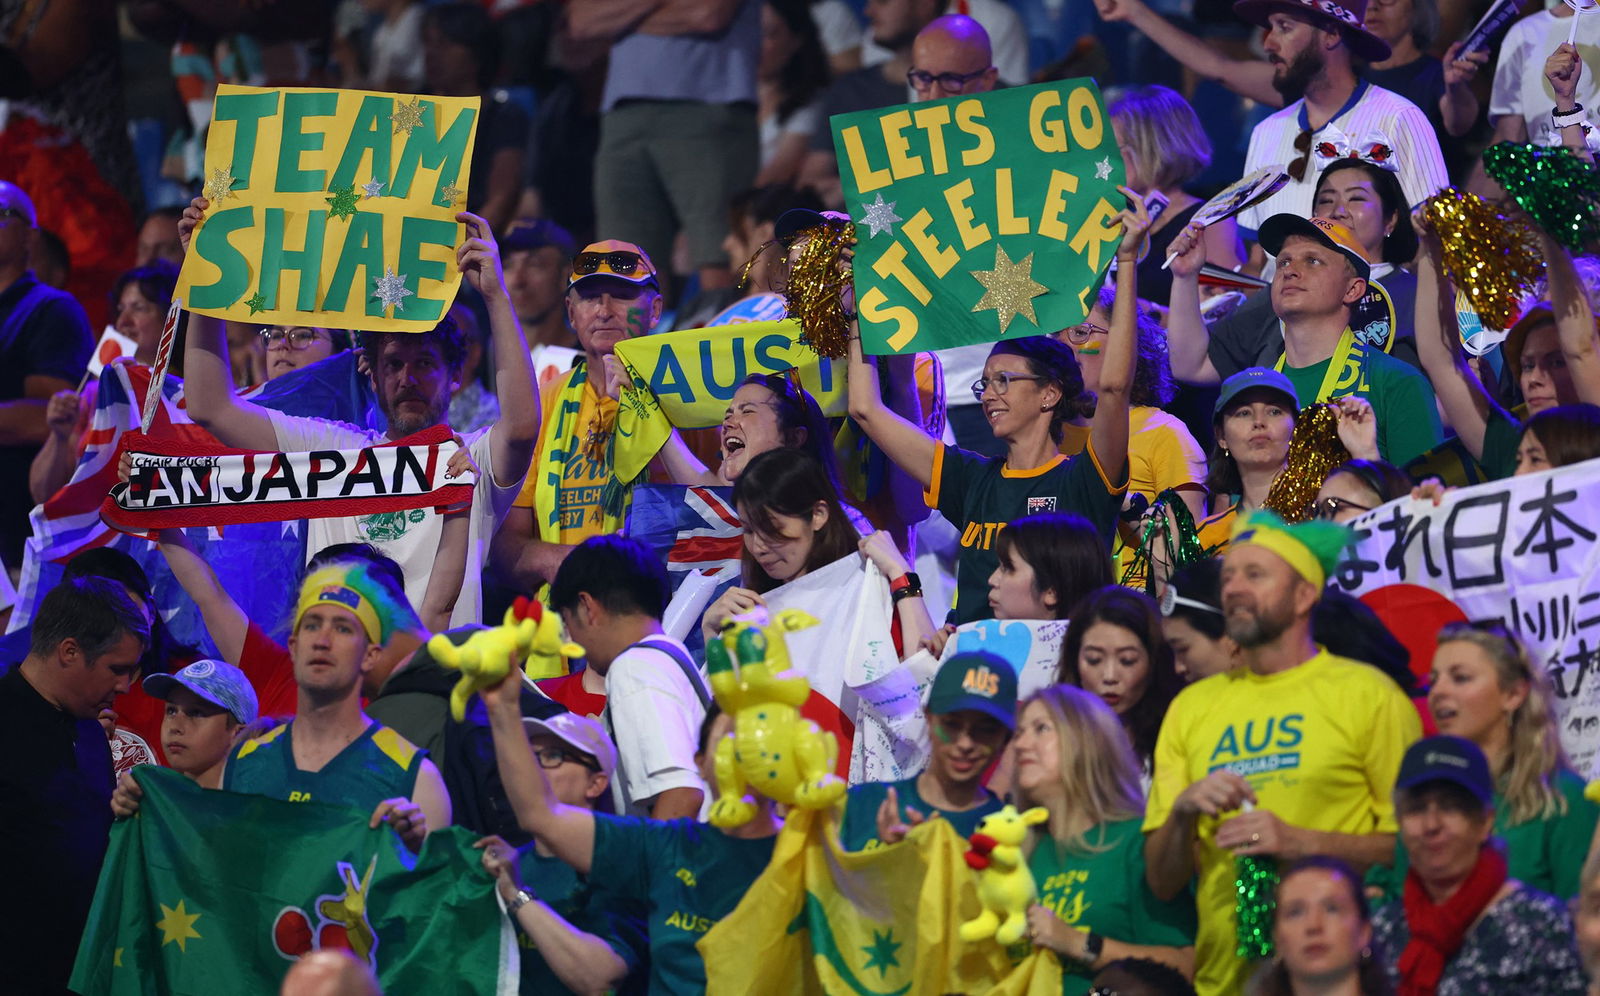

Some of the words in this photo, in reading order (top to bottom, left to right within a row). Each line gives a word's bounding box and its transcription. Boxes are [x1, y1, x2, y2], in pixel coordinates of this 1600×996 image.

[215, 91, 477, 207] TEAM
[841, 99, 996, 193] LETS
[1029, 85, 1104, 153] GO
[1310, 217, 1335, 231] ERS
[188, 205, 459, 322] SHAE
[859, 167, 1122, 352] STEELER
[118, 466, 220, 508] EAM
[223, 444, 440, 502] JAPAN
[131, 456, 172, 468] CHAIR
[560, 489, 601, 505] EELCH
[961, 667, 1000, 695] AUS
[1209, 713, 1304, 762] AUS
[665, 911, 714, 932] AUS
